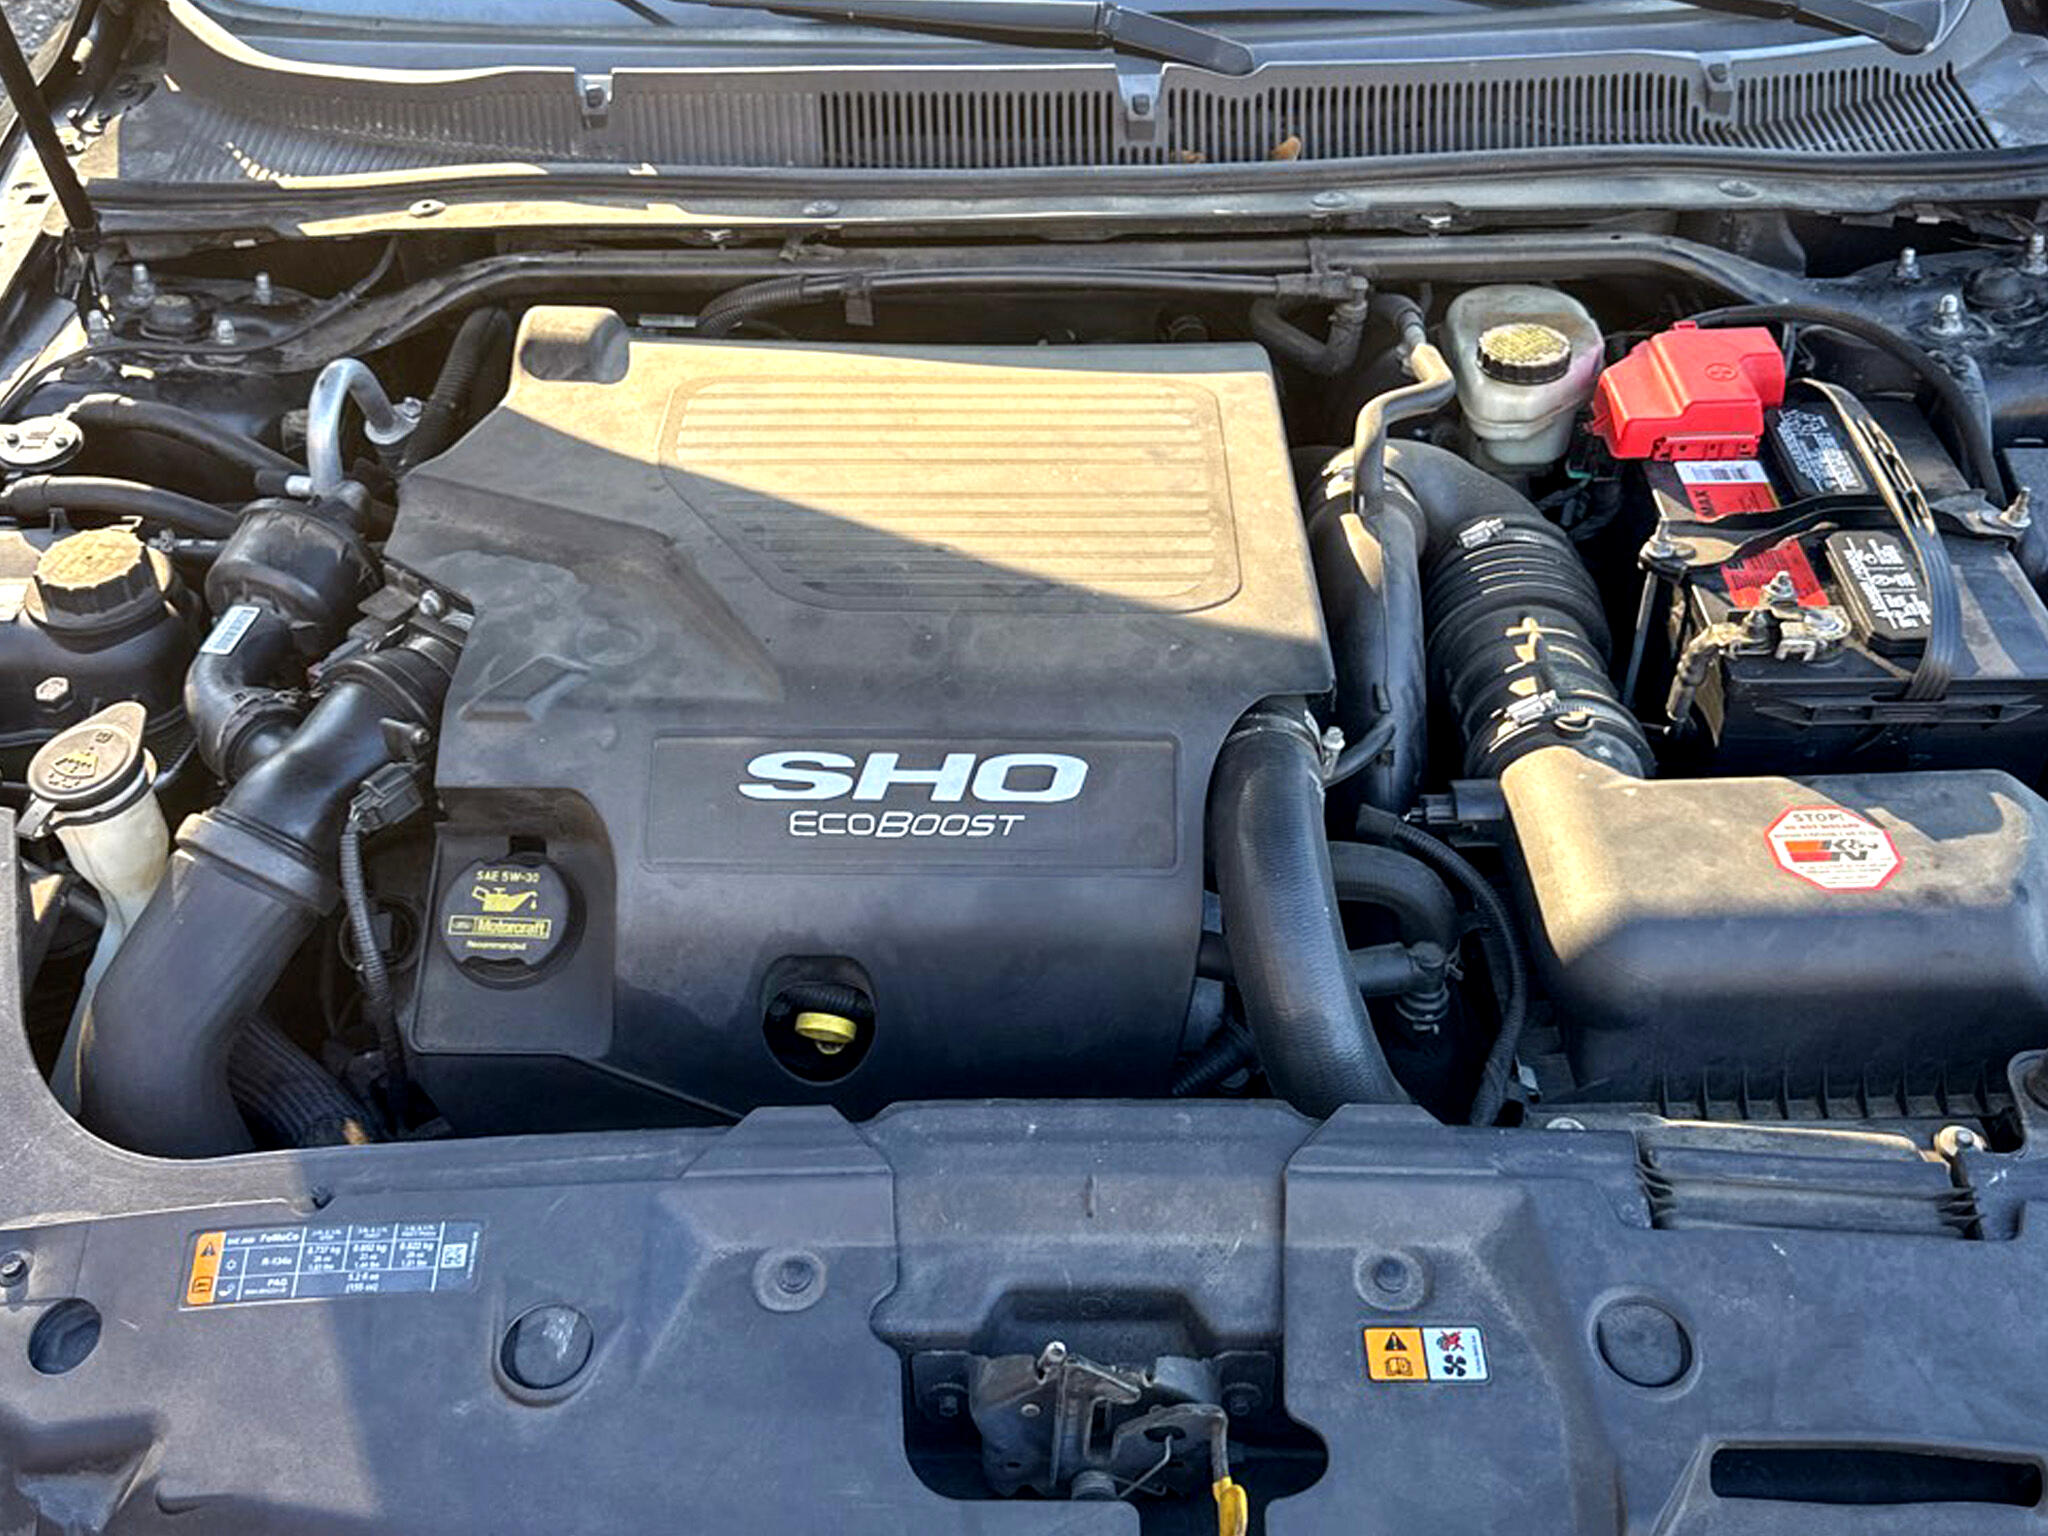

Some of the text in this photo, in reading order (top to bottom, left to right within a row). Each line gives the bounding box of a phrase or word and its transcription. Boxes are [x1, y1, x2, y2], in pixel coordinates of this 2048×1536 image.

[738, 750, 1090, 802] SHO
[476, 870, 499, 882] SAE
[478, 919, 549, 938] Motorcraft
